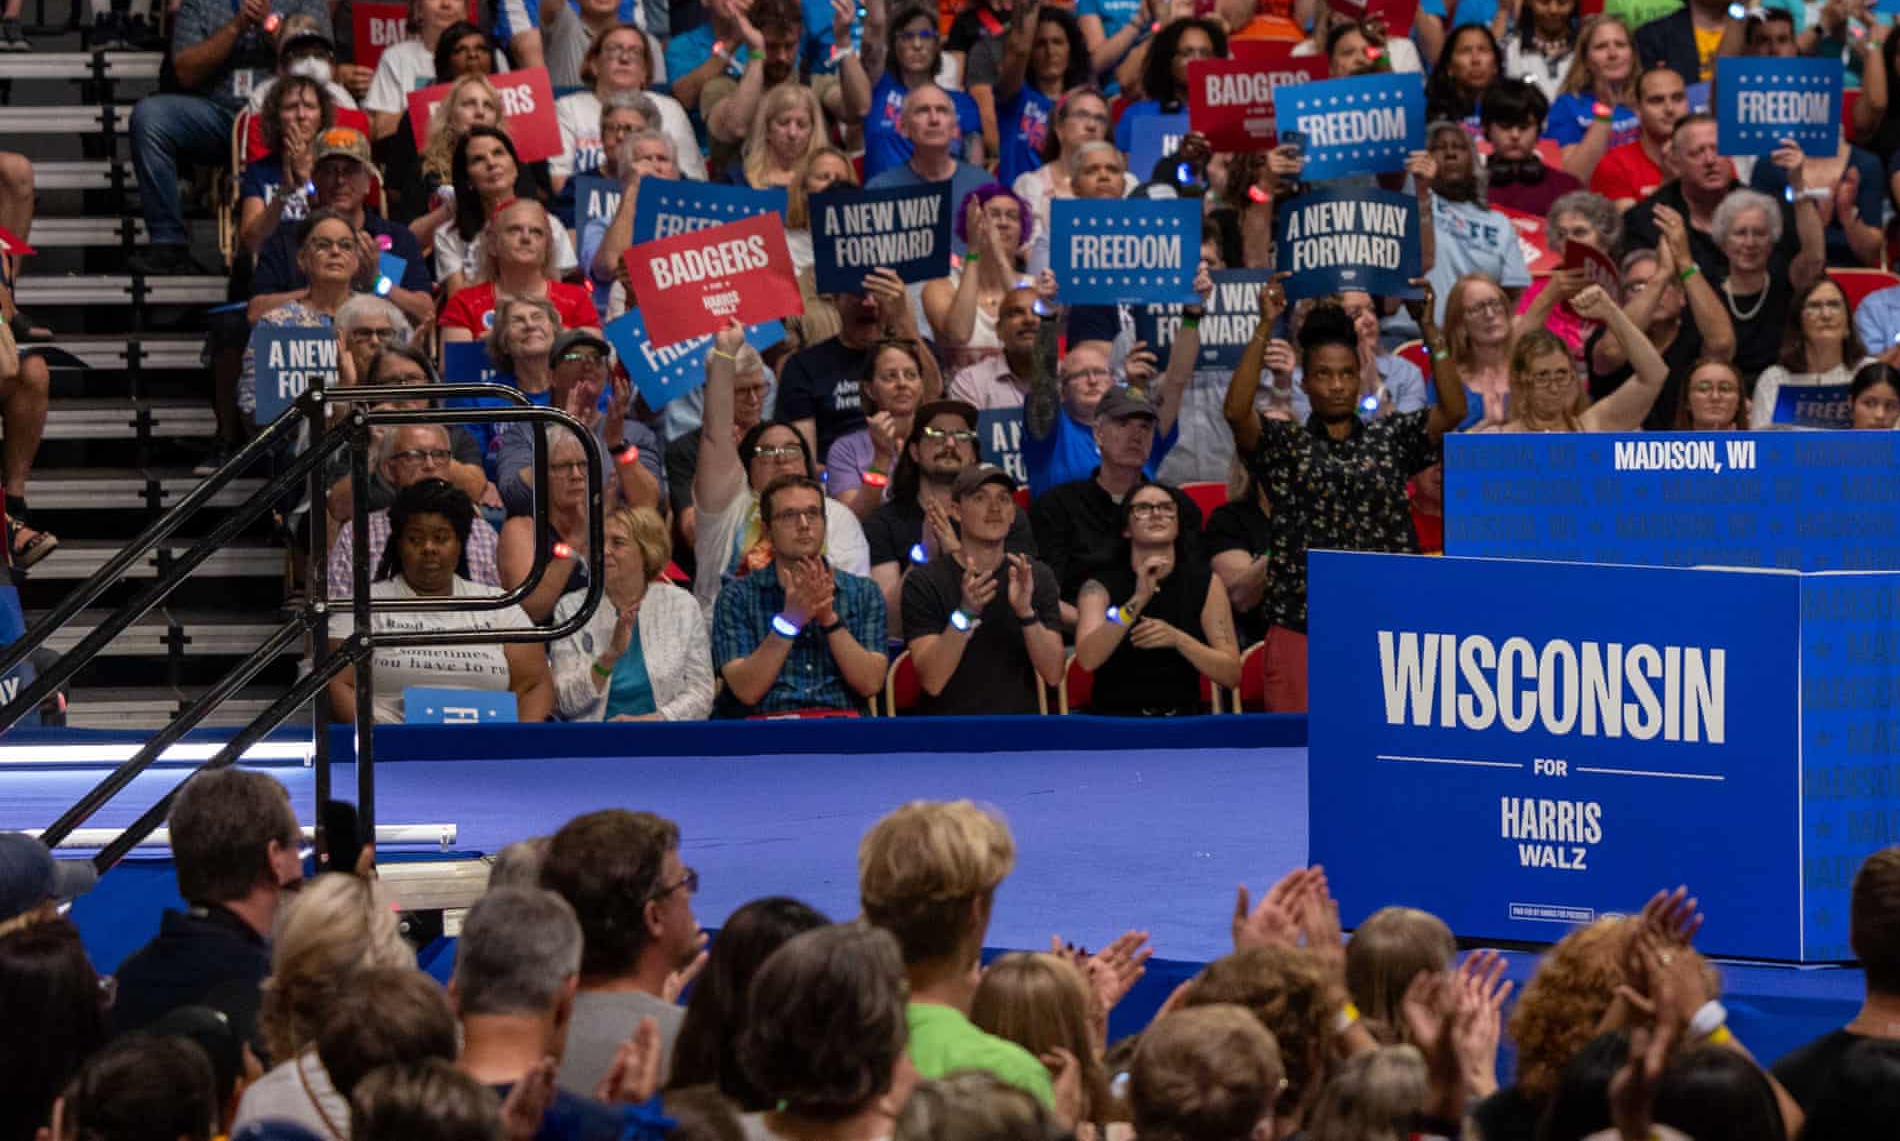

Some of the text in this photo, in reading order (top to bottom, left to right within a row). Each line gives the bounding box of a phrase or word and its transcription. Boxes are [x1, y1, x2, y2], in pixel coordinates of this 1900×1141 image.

[1297, 106, 1407, 147] FREEDOM
[1737, 91, 1831, 124] FREEDOM
[824, 194, 942, 236] A NEW WAY
[1286, 201, 1408, 242] A NEW WAY
[650, 234, 769, 291] BADGERS
[835, 229, 935, 267] FORWARD
[1071, 234, 1181, 270] FREEDOM
[1292, 234, 1401, 272] FORWARD
[268, 339, 338, 368] A NEW
[1613, 440, 1723, 475] MADISON,
[1725, 439, 1757, 470] WI
[1377, 630, 1726, 744] WISCONSIN
[1533, 758, 1568, 777] FOR
[1501, 796, 1602, 844] HARRIS
[1518, 843, 1587, 870] WALZ
